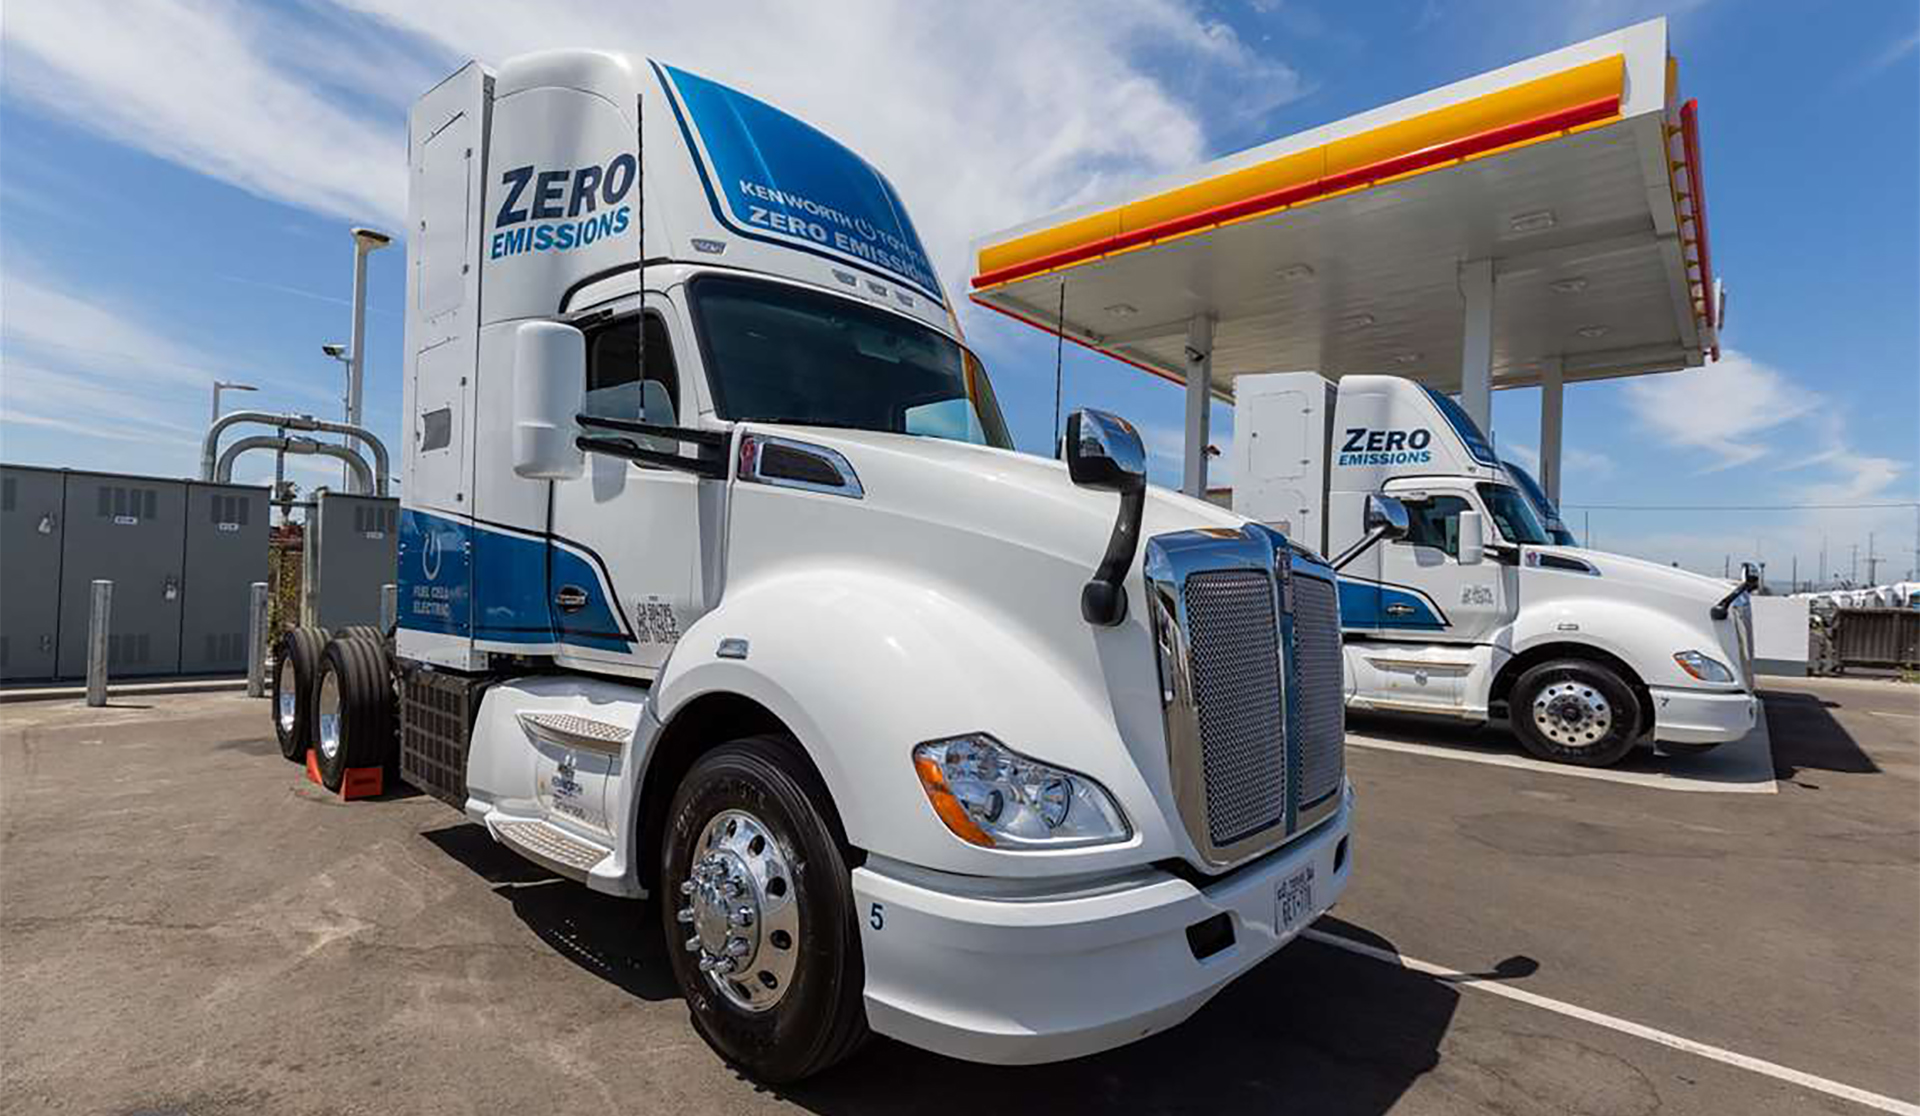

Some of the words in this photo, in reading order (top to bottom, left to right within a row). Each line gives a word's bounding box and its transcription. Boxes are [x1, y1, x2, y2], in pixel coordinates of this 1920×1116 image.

[496, 153, 636, 228] ZERO
[739, 180, 852, 229] KENWORTH
[491, 206, 630, 260] EMISSIONS
[749, 205, 827, 242] ZERO
[1338, 450, 1431, 466] EMISSIONS
[1341, 428, 1431, 452] ZERO
[870, 902, 883, 931] 5
